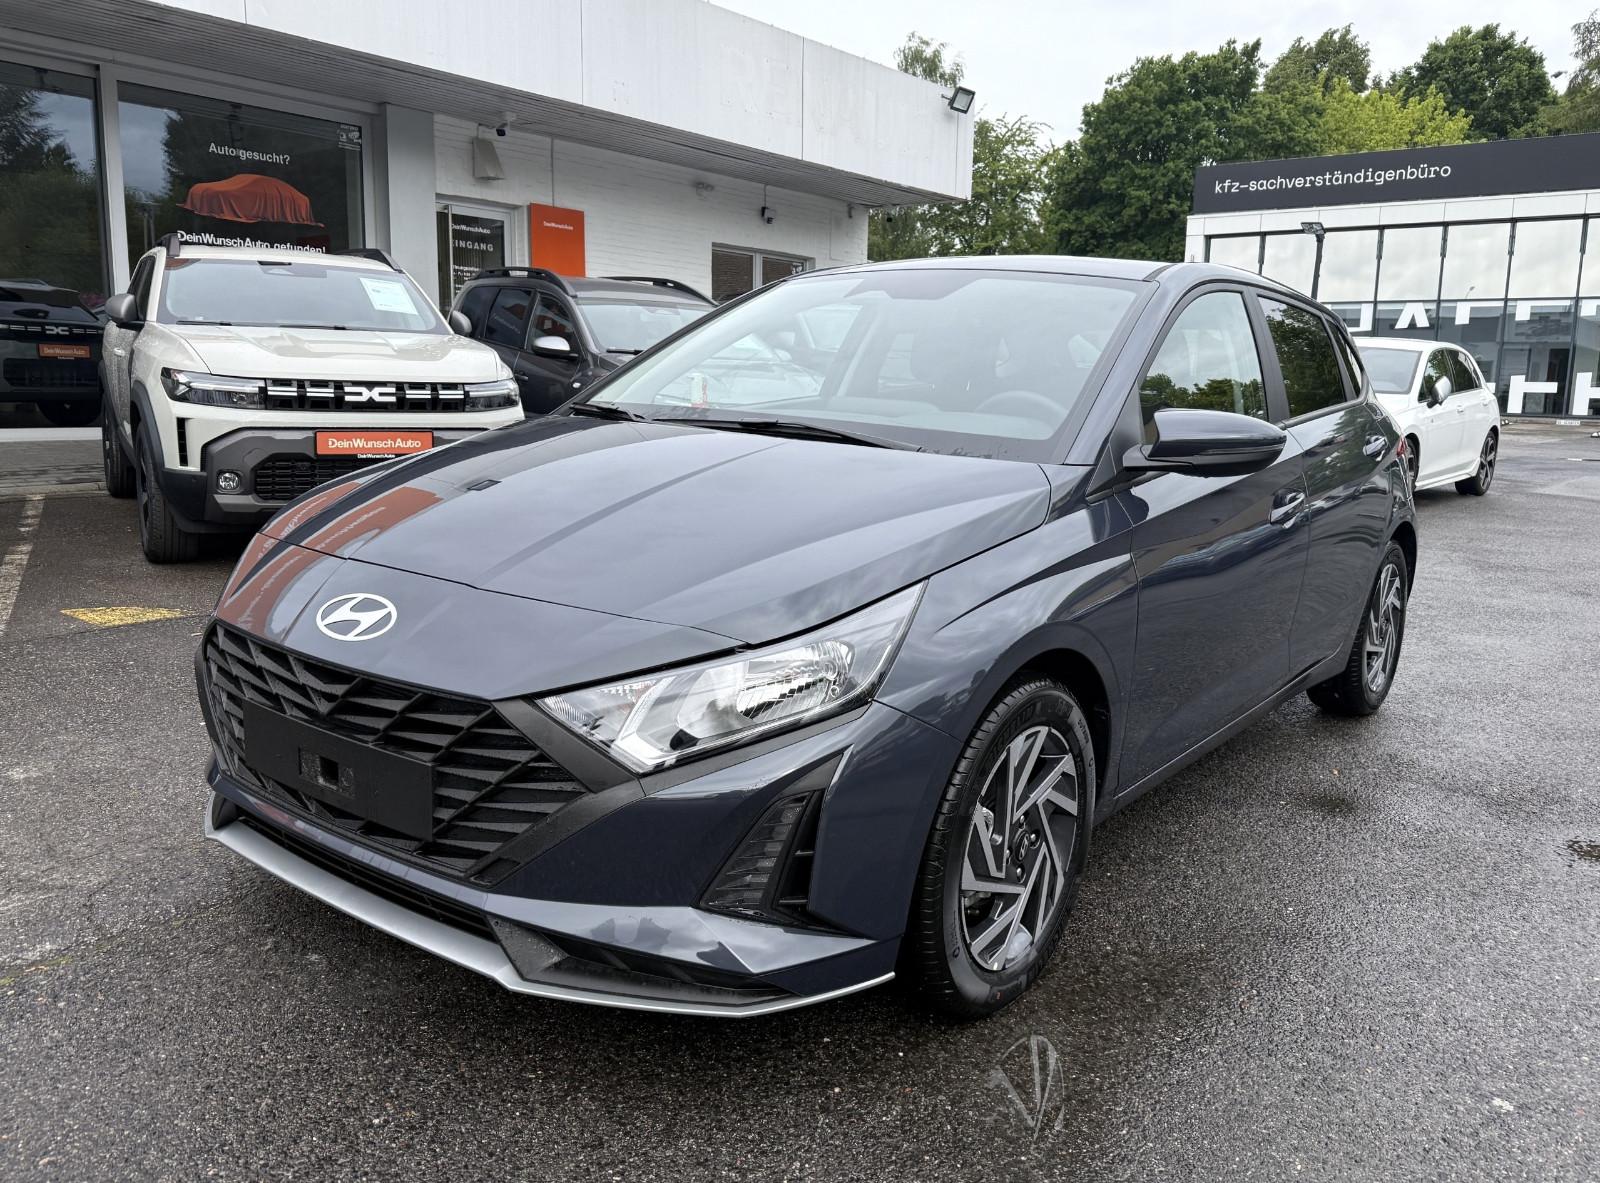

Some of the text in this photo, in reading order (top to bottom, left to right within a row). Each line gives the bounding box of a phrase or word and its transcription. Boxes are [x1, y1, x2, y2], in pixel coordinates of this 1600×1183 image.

[209, 142, 290, 165] Auto gesucht?
[1214, 164, 1452, 194] kfz-sachverständigenbüro
[177, 230, 271, 248] DeinWunschAuto
[328, 438, 421, 449] DeinWunschAuto
